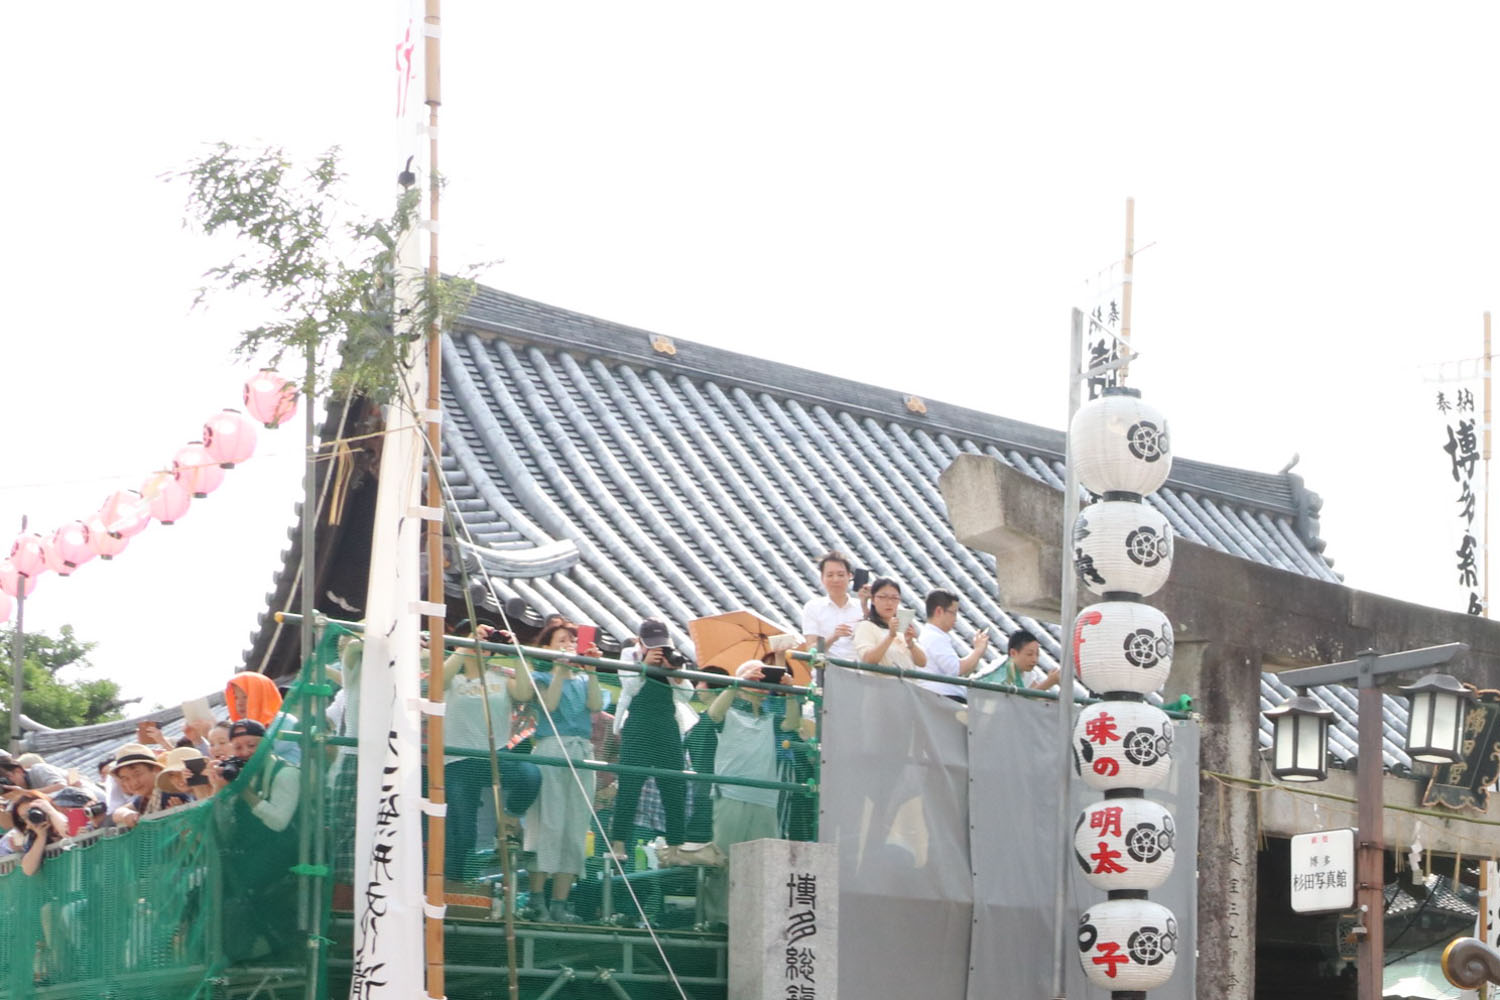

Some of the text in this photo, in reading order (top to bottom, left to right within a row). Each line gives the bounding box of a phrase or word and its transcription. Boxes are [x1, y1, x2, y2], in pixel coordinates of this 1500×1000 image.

[1293, 869, 1348, 891] 杉田写真館
